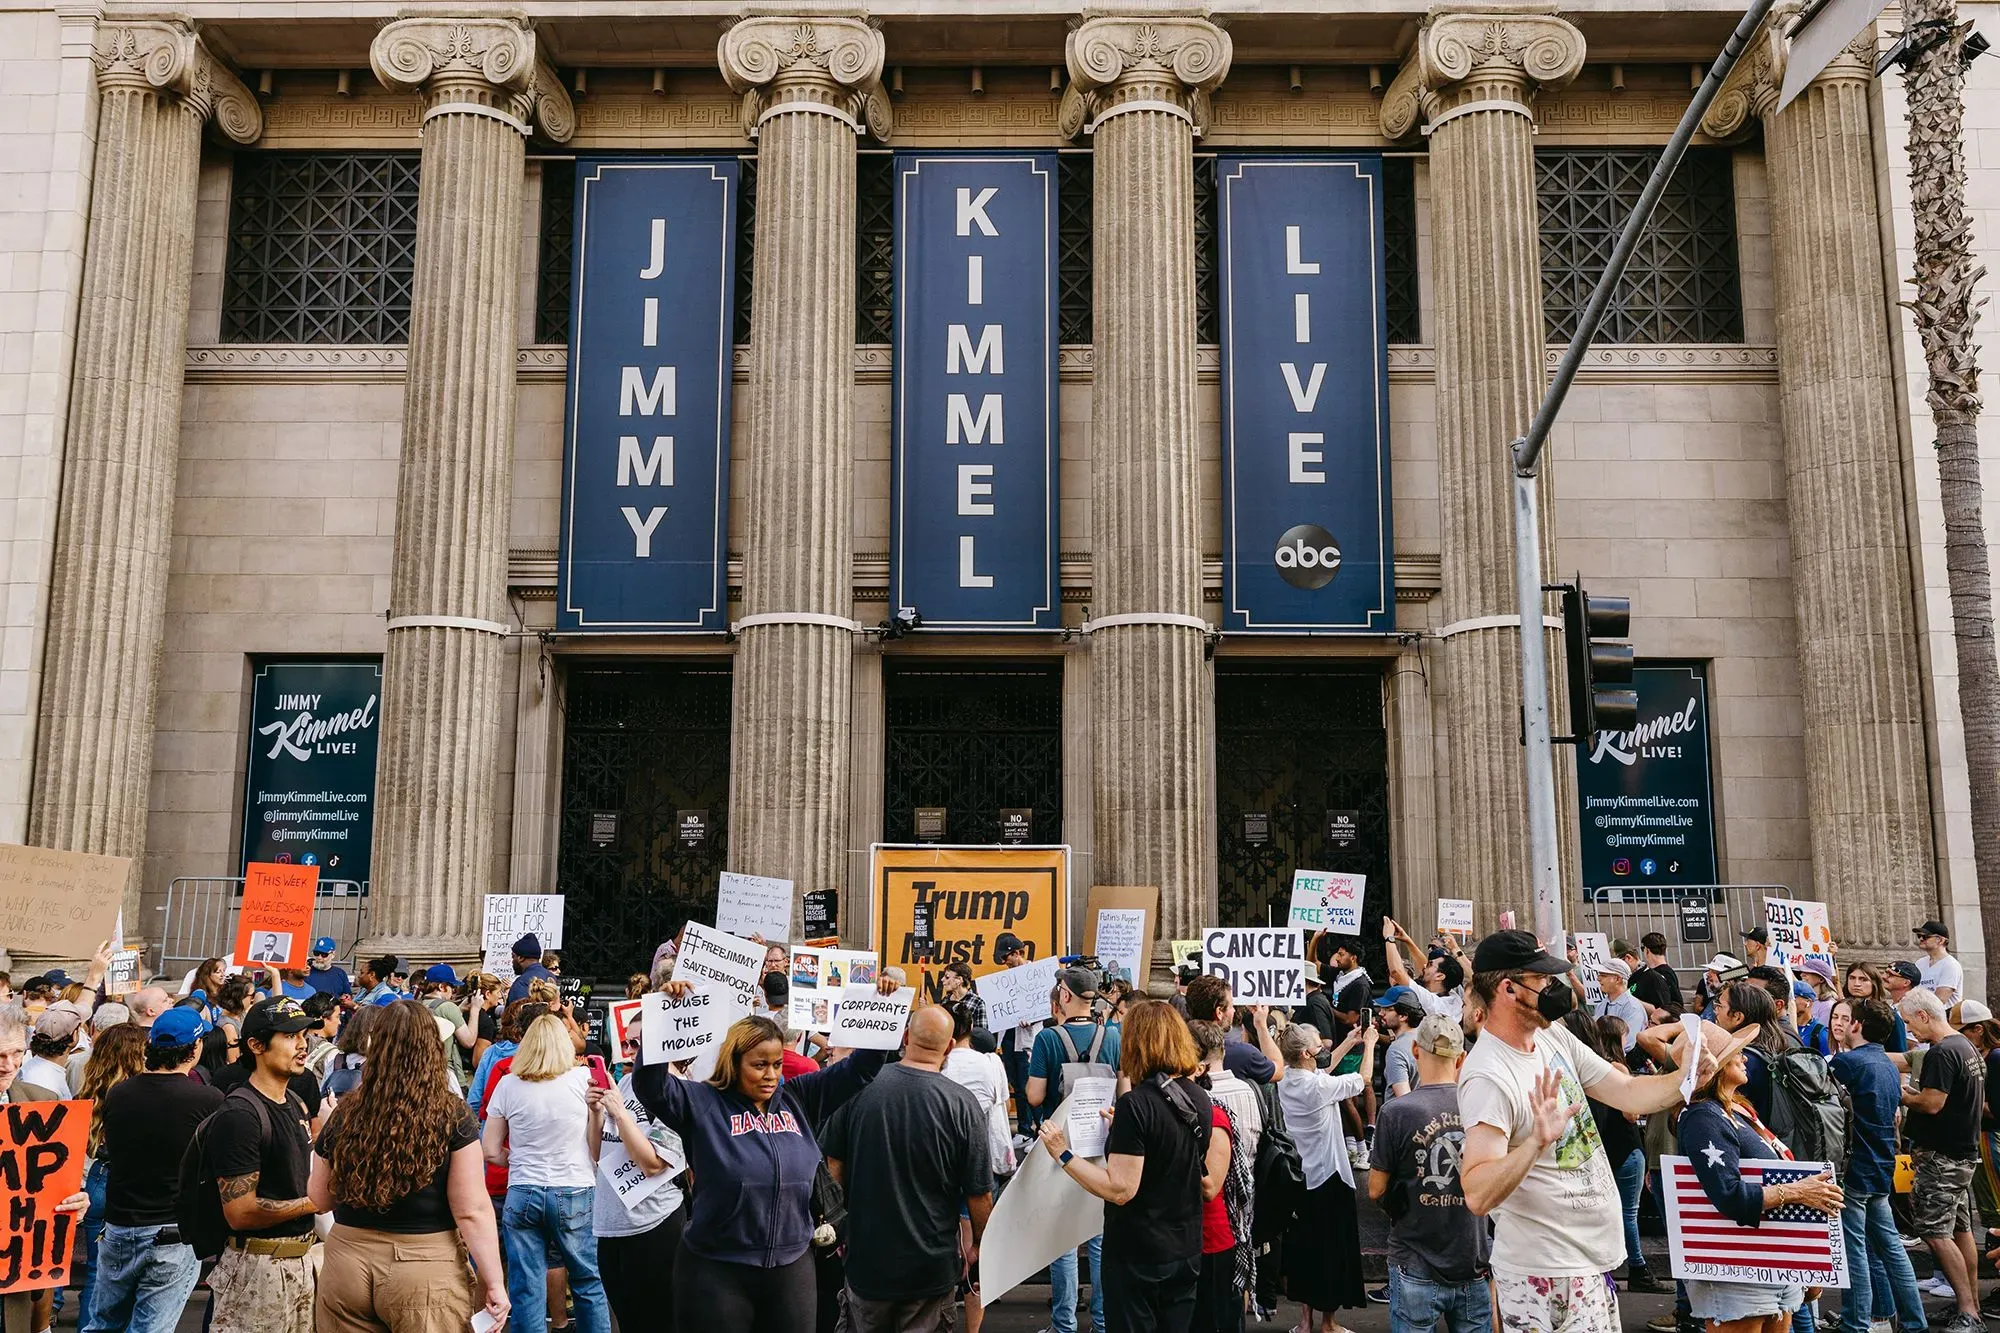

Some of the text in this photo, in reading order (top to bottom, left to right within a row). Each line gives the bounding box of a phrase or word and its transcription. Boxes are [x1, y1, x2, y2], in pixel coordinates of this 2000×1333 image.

[1280, 225, 1327, 483] LIVE
[616, 218, 676, 557] JIMMY
[946, 187, 1004, 587] KIMMEL
[1274, 539, 1341, 568] abc
[274, 694, 321, 710] JIMMY
[259, 694, 376, 762] Kimmel
[316, 742, 356, 754] LIVE!
[1641, 746, 1682, 758] LIVE!
[257, 791, 367, 805] JimmyKimmelLive.com
[1586, 796, 1699, 809] JimmyKimmelLive.com
[263, 810, 359, 823] @JimmyKimmelLive
[687, 816, 699, 824] NO
[1010, 814, 1022, 823] NO
[1337, 816, 1349, 824] NO
[1594, 815, 1693, 828] @JimmyKimmelLive
[271, 828, 348, 842] @JimmyKimmel
[1606, 834, 1685, 847] @JimmyKimmel
[254, 872, 308, 888] THIS WEEK
[726, 875, 739, 884] The
[1296, 878, 1352, 892] FREE JIMMY
[911, 881, 1030, 929] Trump
[1321, 896, 1329, 907] &
[69, 905, 92, 921] YOU
[245, 900, 311, 918] UNNECESSARY
[1292, 907, 1354, 924] FREE SPEECH
[246, 914, 305, 928] CENSORSHIP
[523, 914, 545, 931] FOR
[1330, 917, 1356, 926] 4 ALL
[1586, 937, 1595, 949] I
[1772, 927, 1802, 949] FREE
[682, 927, 758, 970] #FREEJIMMY
[1206, 931, 1302, 960] CANCEL
[112, 950, 138, 960] UMP
[801, 956, 812, 964] NO
[1581, 951, 1602, 966] AM
[109, 960, 136, 971] MUST
[793, 963, 819, 973] KINGS
[116, 971, 129, 981] GO
[682, 958, 755, 995] SAVE DEMOCRA
[991, 974, 1017, 990] YOU
[661, 994, 710, 1011] DOUSE
[737, 993, 752, 1007] CY
[992, 998, 1020, 1019] FREE
[1025, 990, 1050, 1009] SPEE
[841, 1000, 908, 1015] CORPORATE
[673, 1016, 700, 1031] THE
[841, 1018, 898, 1032] COWARDS
[661, 1032, 713, 1051] MOUSE
[0, 1104, 69, 1146] W
[1683, 1263, 1718, 1277] CRITICS
[1778, 1269, 1840, 1285] FASCISM
